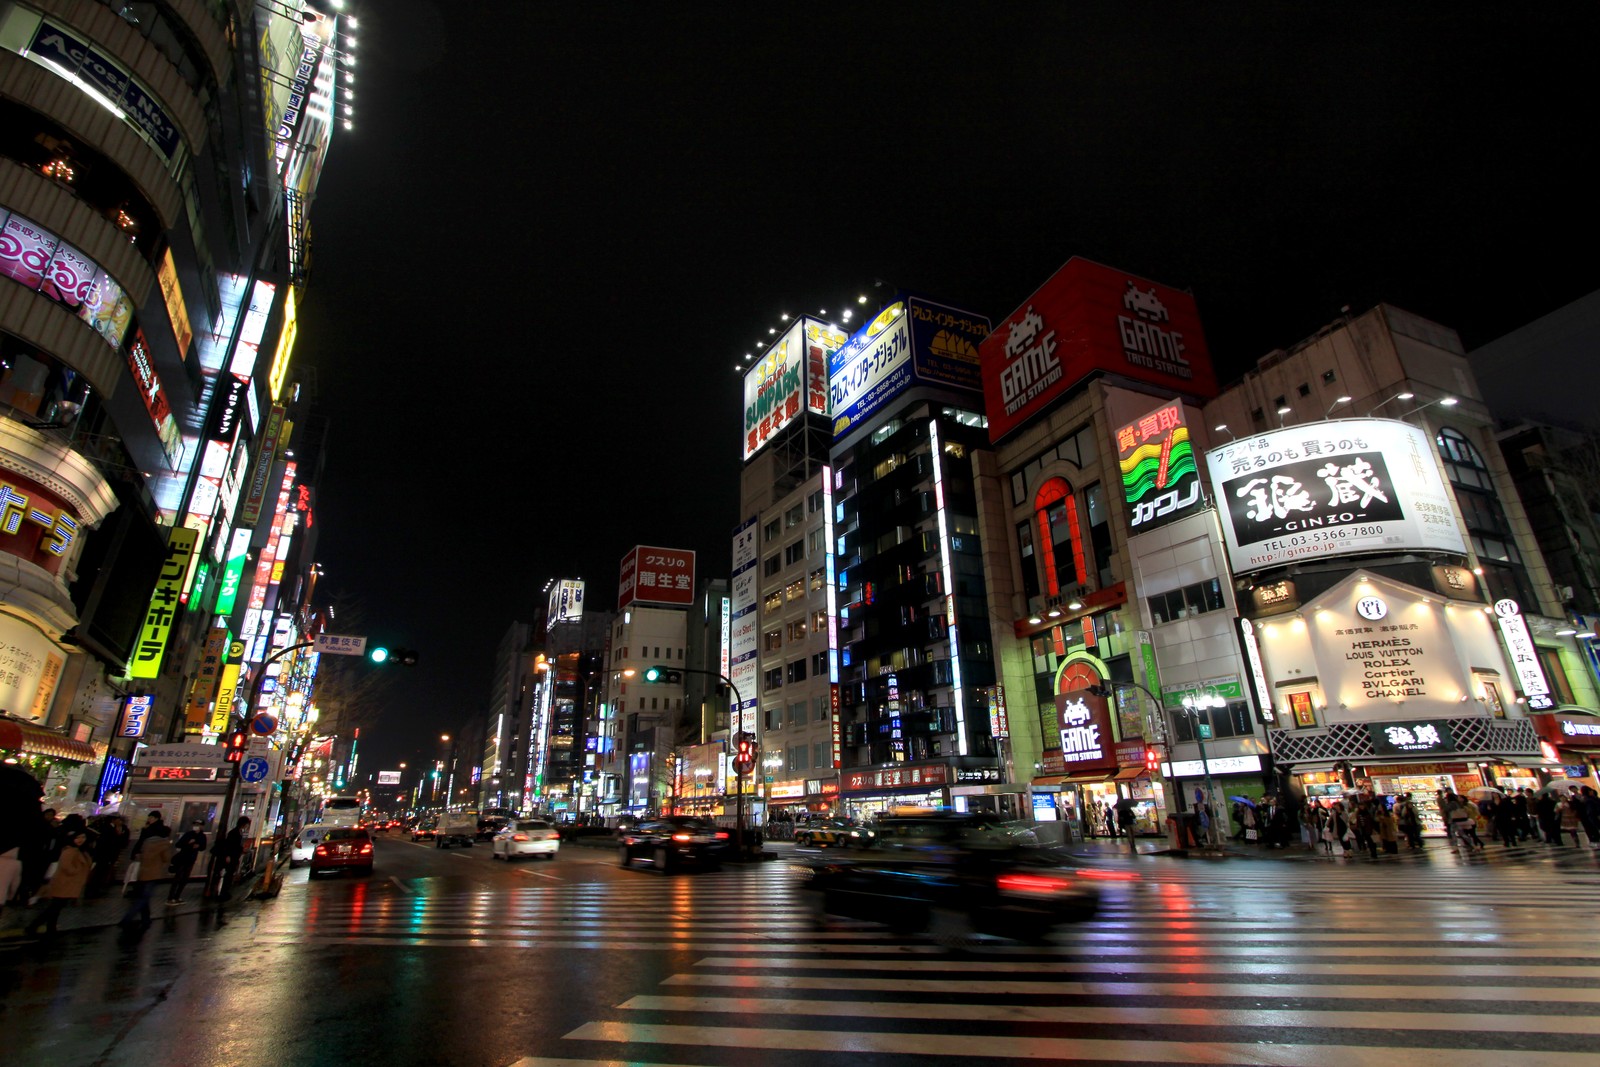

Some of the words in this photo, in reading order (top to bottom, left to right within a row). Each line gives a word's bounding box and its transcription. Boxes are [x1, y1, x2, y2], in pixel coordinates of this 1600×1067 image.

[8, 220, 90, 273] 高収入求人サイト
[1118, 315, 1190, 365] GAME
[831, 326, 907, 409] アムス・インターナショナル
[1000, 330, 1060, 405] GAME
[1126, 351, 1153, 368] TAITO
[1155, 359, 1193, 379] STATION
[745, 359, 800, 431] SUNPARK
[1005, 395, 1027, 416] TAITO
[1028, 365, 1063, 402] STATION
[1215, 439, 1270, 463] ブランド品
[1231, 450, 1300, 475] 売るのも
[1302, 437, 1369, 458] 買うのも
[1236, 457, 1389, 522] 銀蔵
[1131, 480, 1199, 527] カワノ
[1264, 525, 1384, 552] TEL.03-5366-7800
[645, 555, 686, 568] クスリの
[1250, 542, 1336, 564] http://ginzo.jp
[222, 569, 239, 596] レイク
[639, 570, 691, 590] 龍生堂
[138, 541, 190, 662] ドン・キホーテ
[319, 635, 362, 648] 歌舞伎町
[1345, 651, 1374, 660] LOUIS
[1379, 647, 1424, 658] VUITTON
[1352, 636, 1411, 650] HERMÈS
[1363, 658, 1411, 669] ROLEX
[1364, 668, 1415, 679] Cartier
[1362, 678, 1425, 690] BVLGARI
[1365, 688, 1426, 699] CHANEL
[216, 688, 232, 721] プロミス
[124, 704, 147, 737] ダイコク
[1060, 724, 1101, 753] GAME
[1064, 752, 1080, 762] TAITO
[1079, 750, 1103, 761] STATION
[1188, 759, 1245, 771] カワトラスト
[158, 767, 191, 779] 下さい
[244, 762, 259, 779] P
[252, 771, 262, 779] 40
